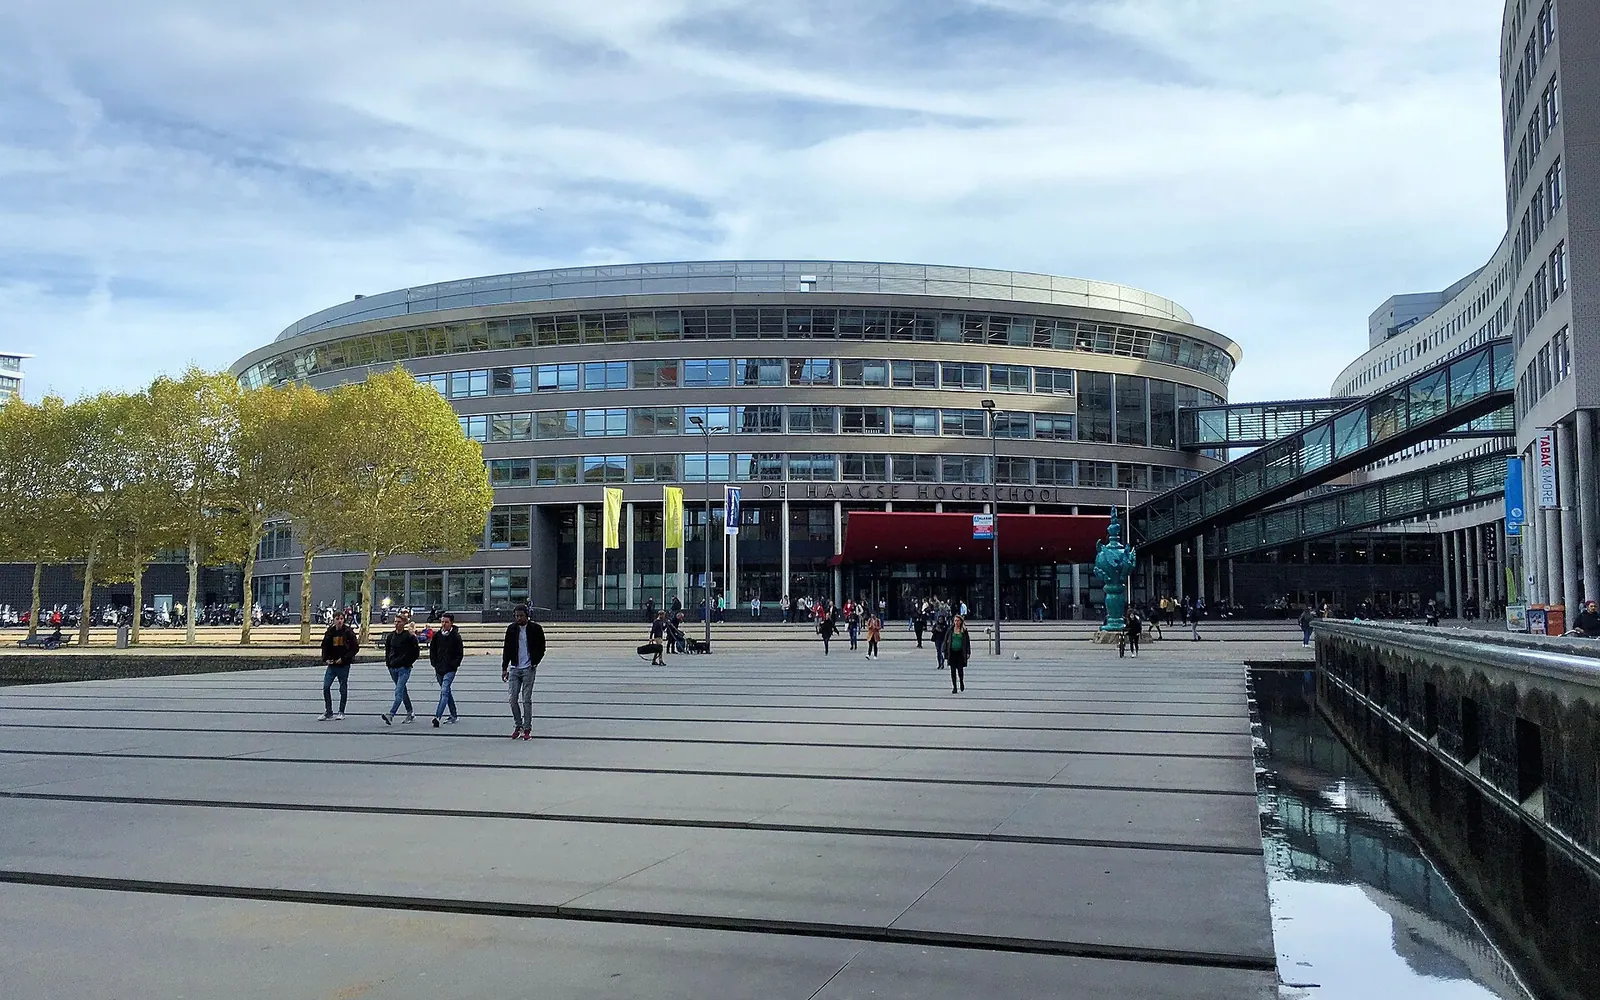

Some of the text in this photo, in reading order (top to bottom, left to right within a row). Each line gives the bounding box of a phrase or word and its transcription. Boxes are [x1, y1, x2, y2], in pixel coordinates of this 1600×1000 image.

[1540, 435, 1551, 466] TABAK
[762, 484, 1061, 502] DE HAAGSE HOGESCHOOL
[1542, 475, 1554, 503] MORE
